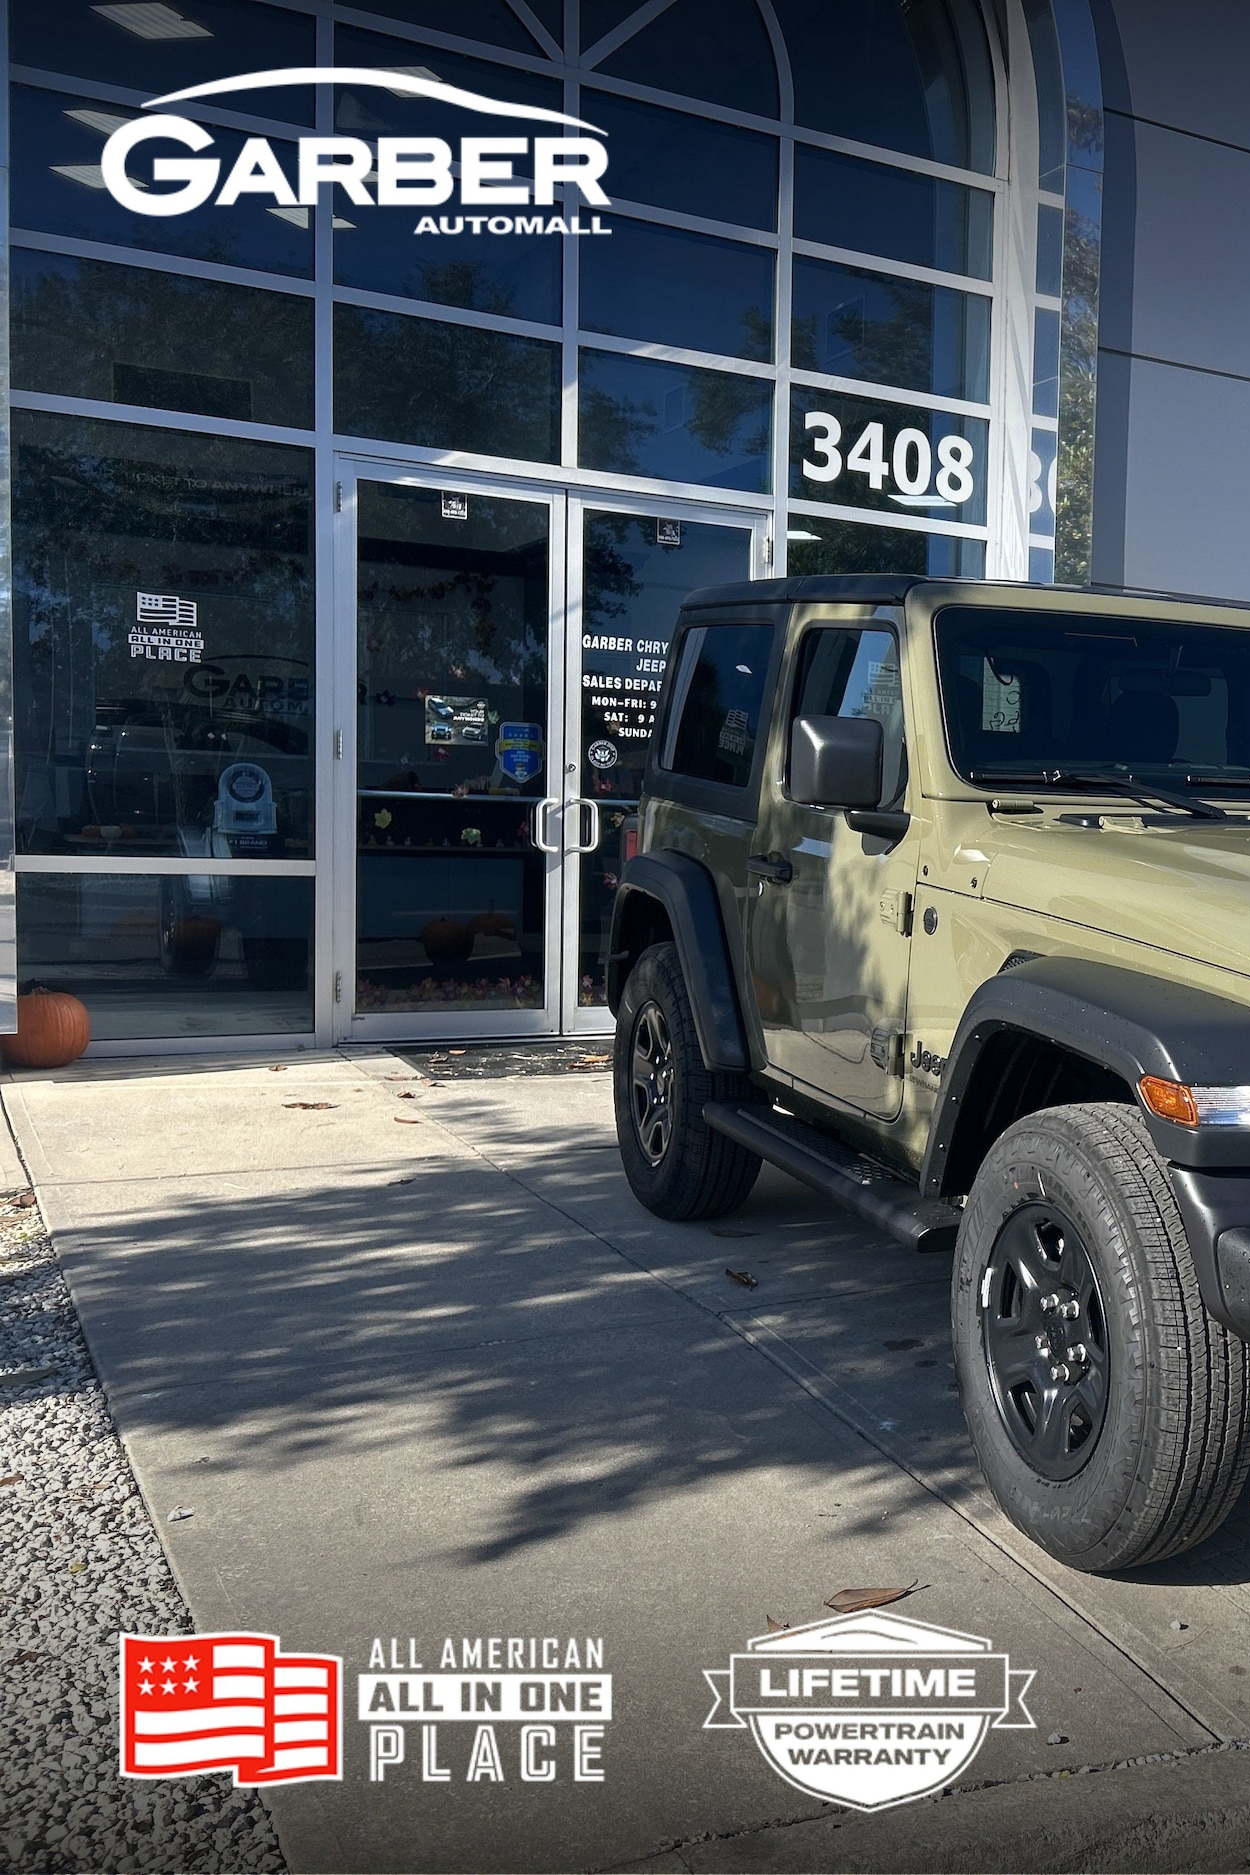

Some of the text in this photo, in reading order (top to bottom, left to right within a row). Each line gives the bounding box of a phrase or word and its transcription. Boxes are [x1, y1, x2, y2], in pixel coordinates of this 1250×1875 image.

[802, 411, 974, 503] 3408
[130, 626, 202, 639] ALL AMERICAN
[131, 635, 201, 648] ALL IN ONE
[582, 634, 669, 655] GARBER CHRY
[130, 644, 202, 663] PLACE
[582, 675, 622, 690] SALES
[650, 700, 657, 709] 9
[604, 711, 629, 722] SAT:
[637, 714, 645, 723] 9
[618, 727, 653, 738] SUND
[910, 1040, 942, 1077] Jee
